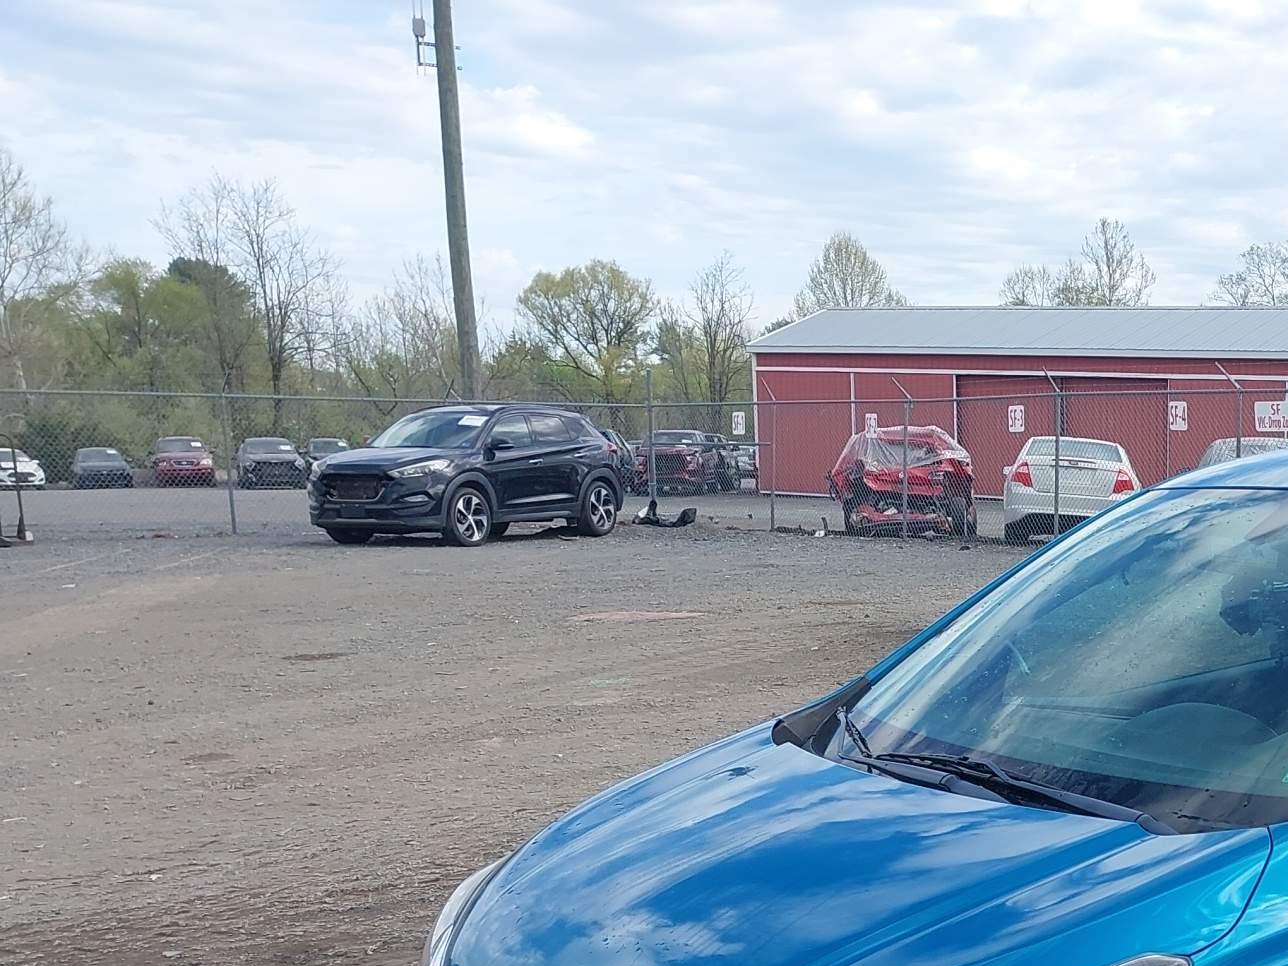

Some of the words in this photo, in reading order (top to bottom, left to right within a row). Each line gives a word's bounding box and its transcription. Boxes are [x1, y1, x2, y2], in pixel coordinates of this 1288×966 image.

[1009, 409, 1023, 428] SF-3
[1170, 405, 1186, 426] SF-4
[1270, 403, 1281, 416] SF
